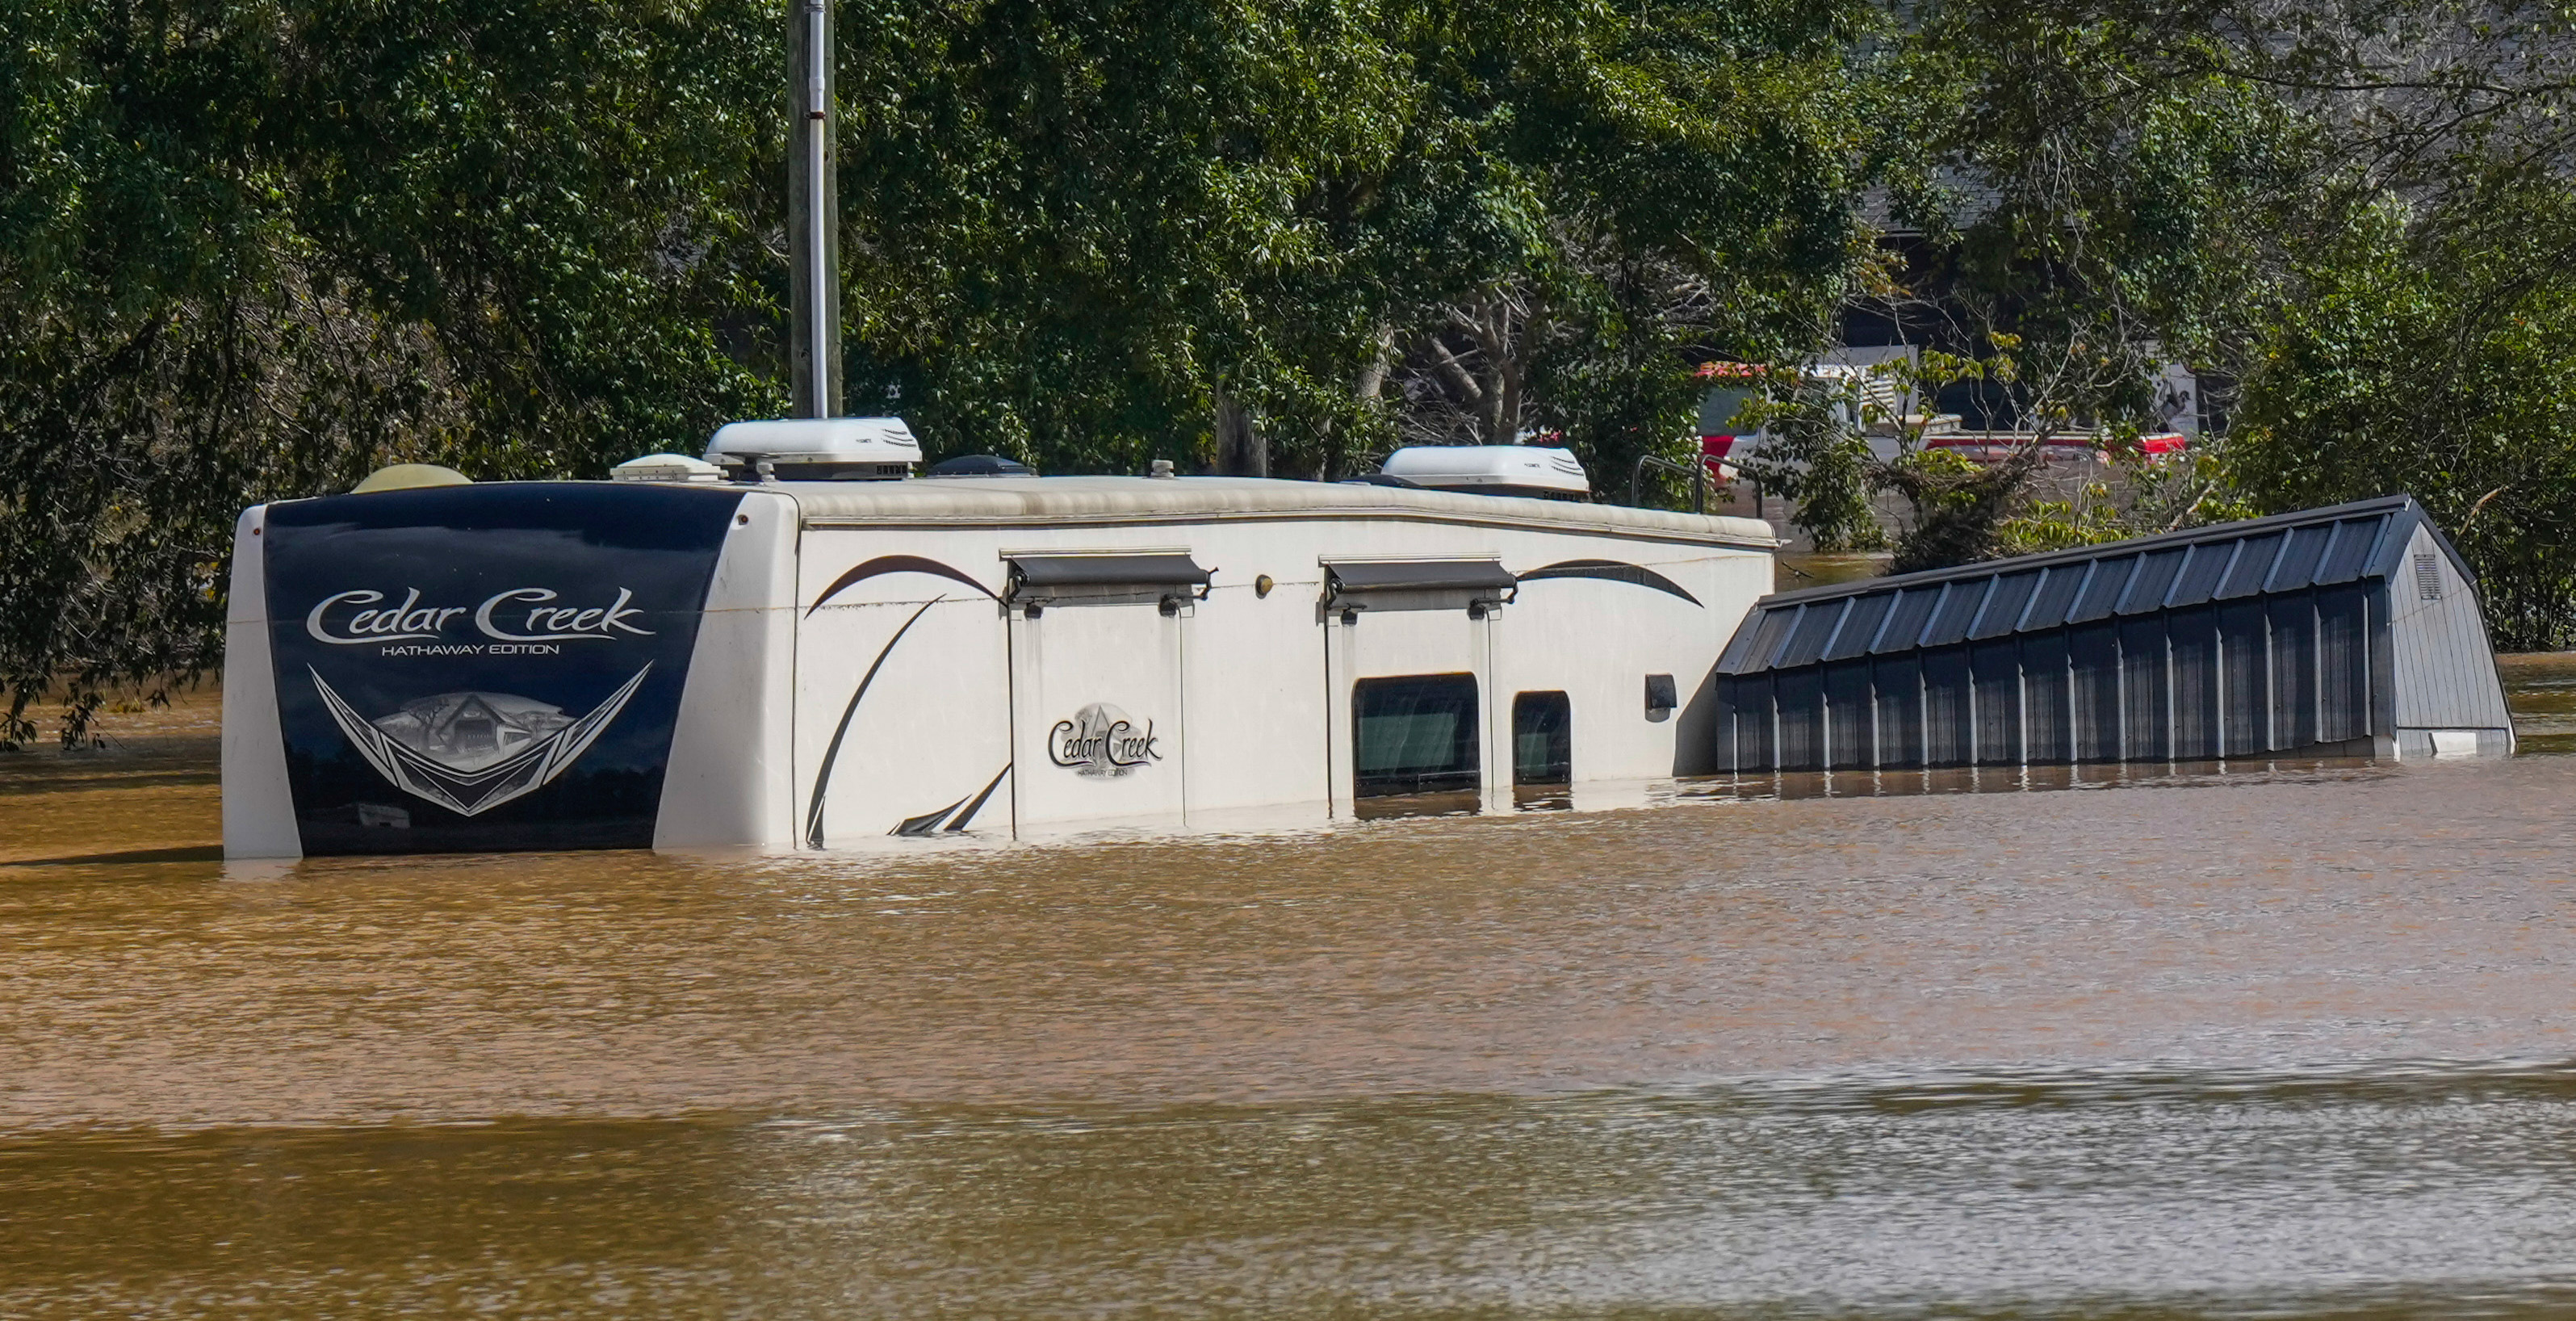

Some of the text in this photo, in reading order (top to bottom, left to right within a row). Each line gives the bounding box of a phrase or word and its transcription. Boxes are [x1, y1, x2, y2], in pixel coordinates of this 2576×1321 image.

[307, 586, 656, 644] Cedar Creek
[382, 644, 559, 656] HATHAWAY EDITION
[1048, 717, 1162, 767] Cedar Creek
